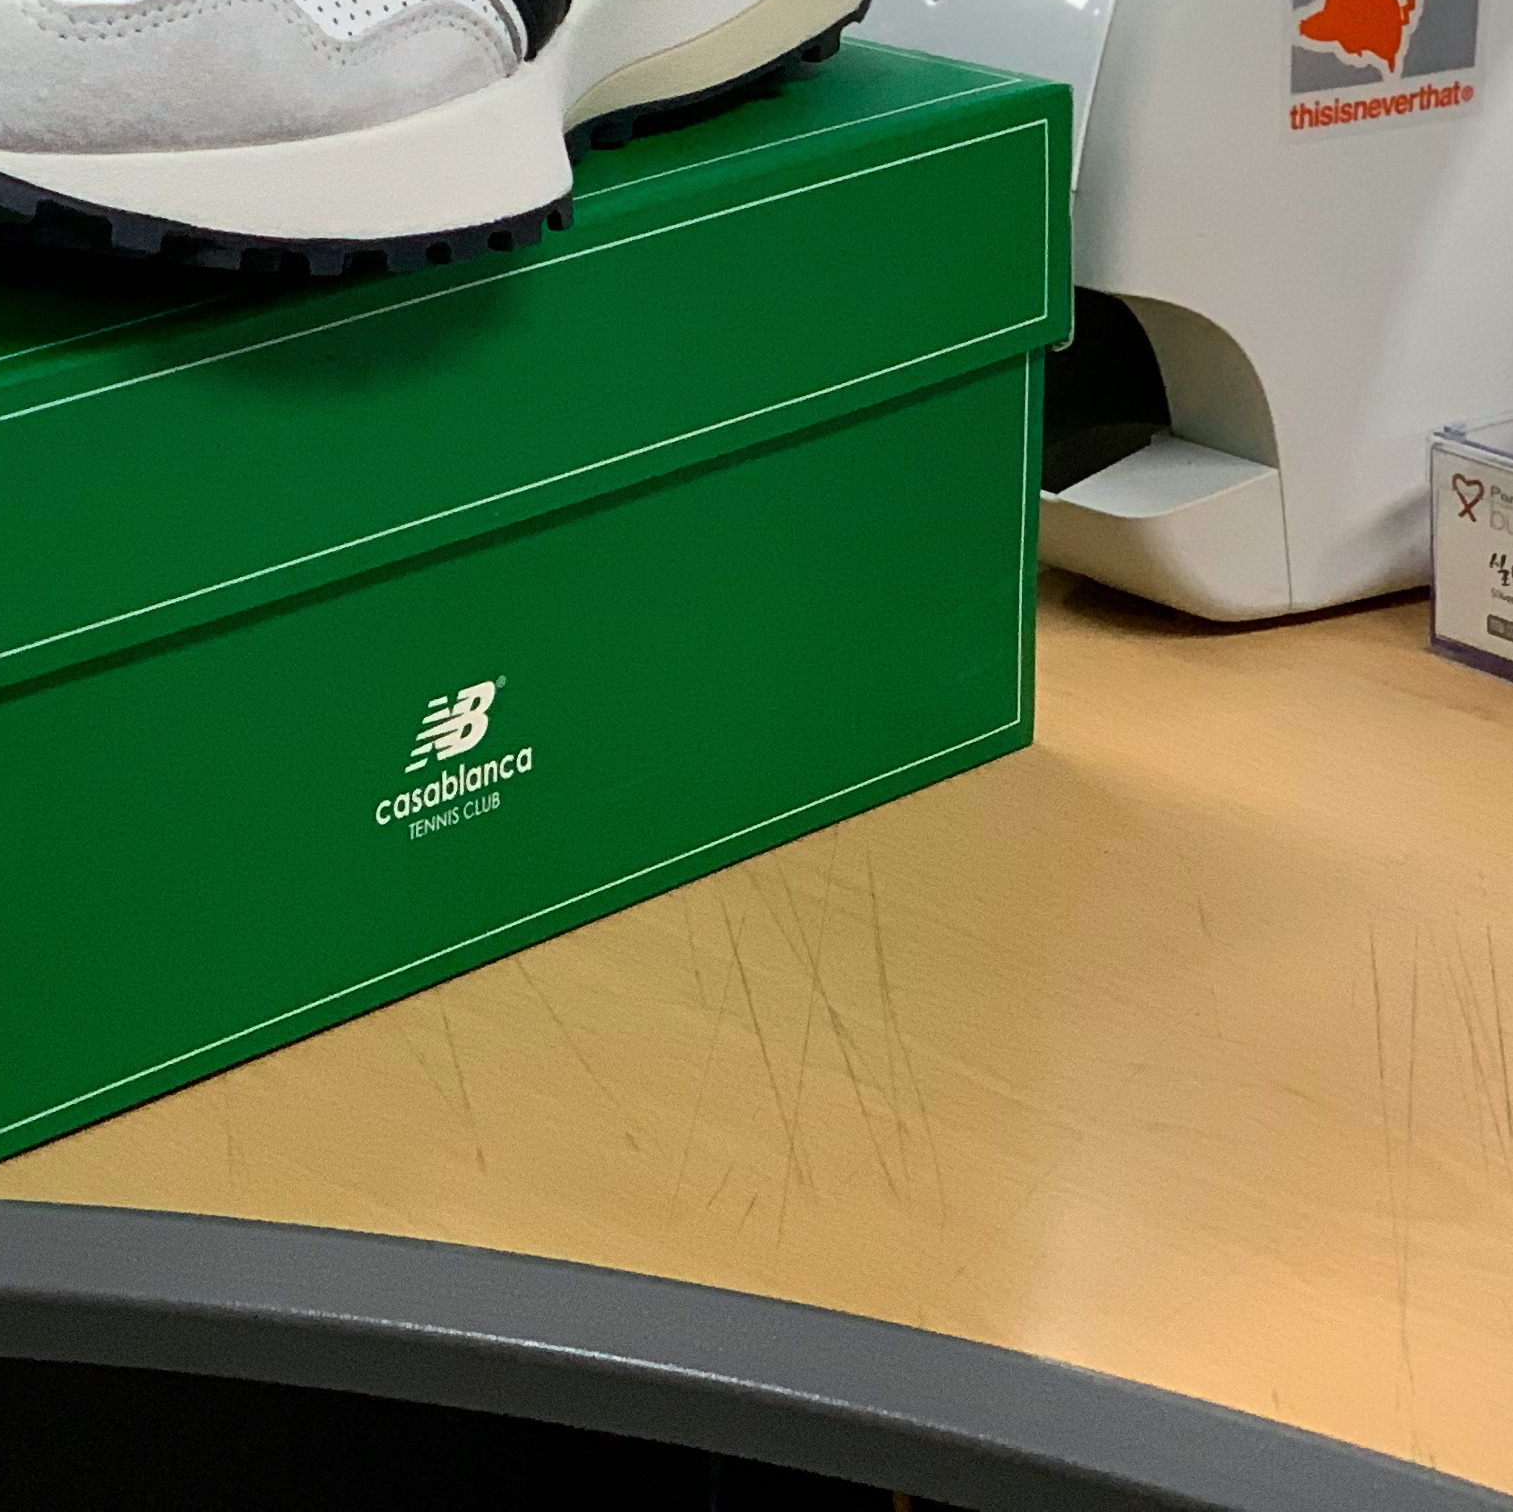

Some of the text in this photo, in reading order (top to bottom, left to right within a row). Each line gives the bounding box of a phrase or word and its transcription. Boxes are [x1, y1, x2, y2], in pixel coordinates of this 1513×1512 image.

[375, 746, 534, 826] casablanca
[408, 791, 502, 840] TENNIS CLUB
